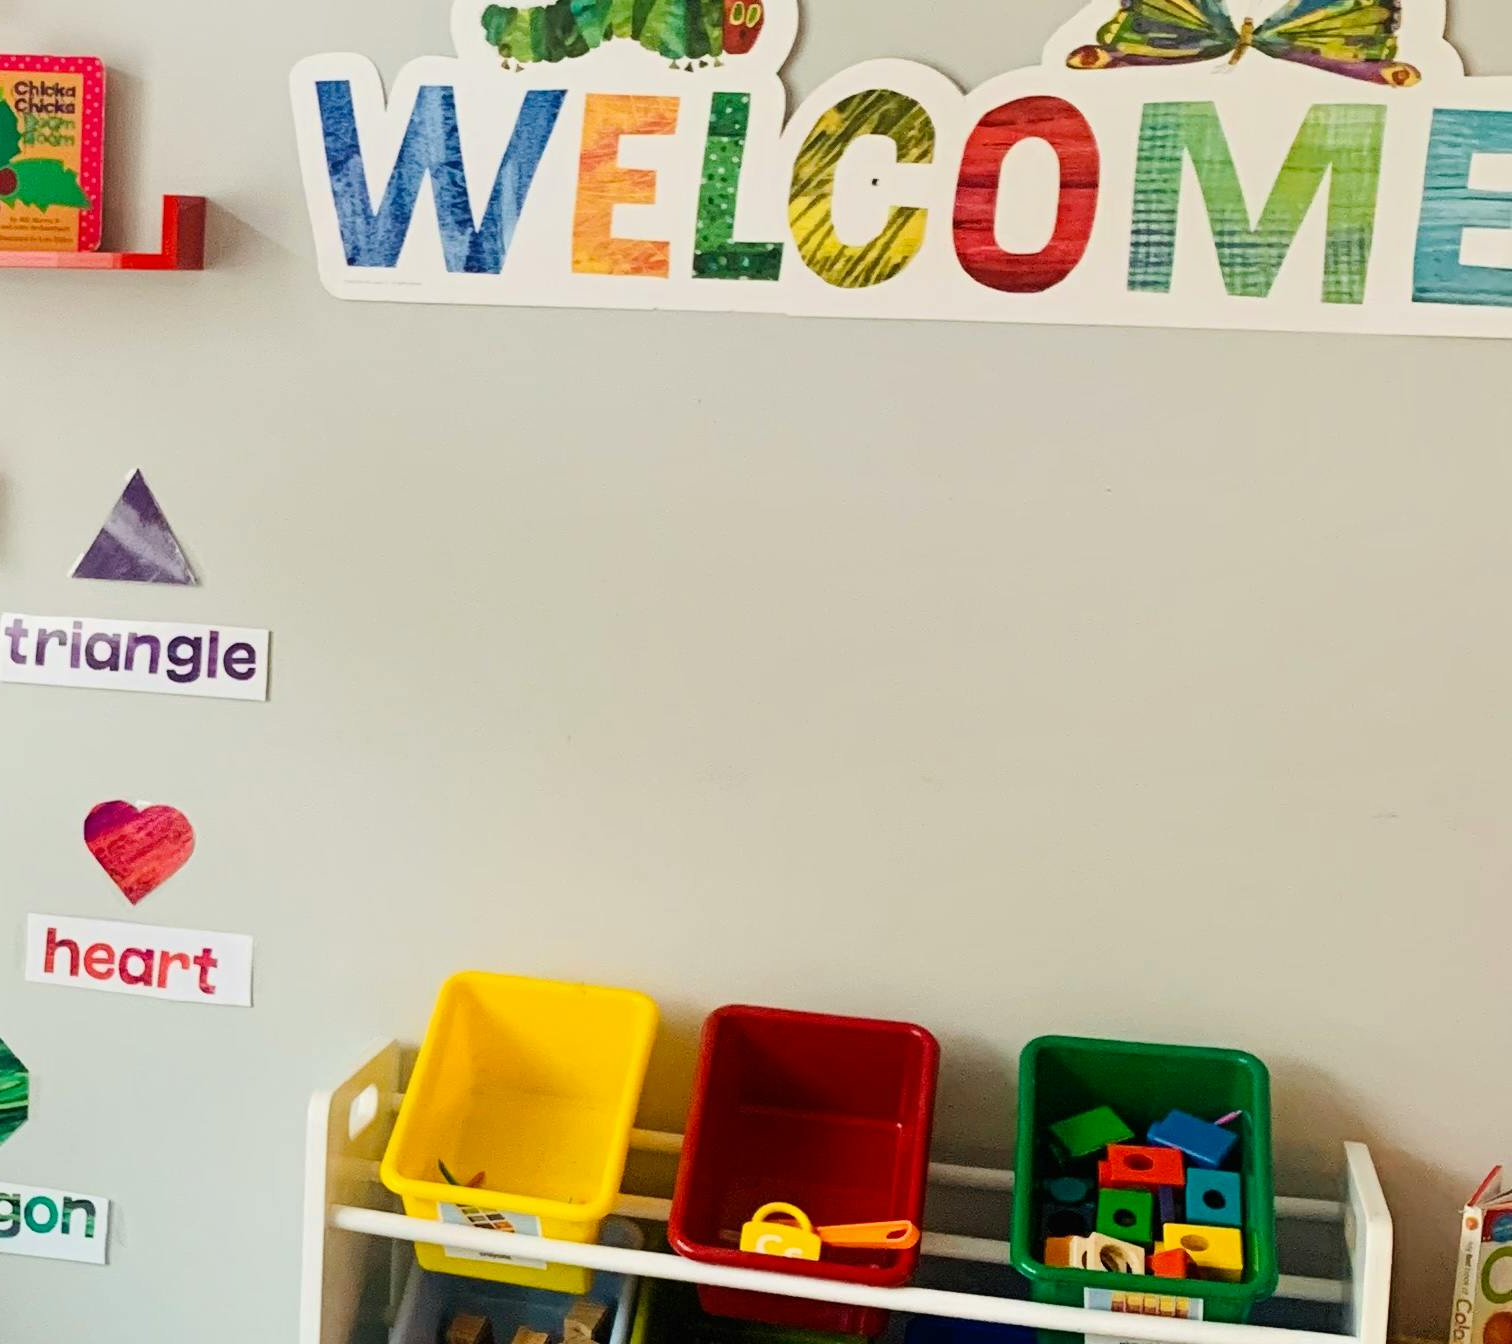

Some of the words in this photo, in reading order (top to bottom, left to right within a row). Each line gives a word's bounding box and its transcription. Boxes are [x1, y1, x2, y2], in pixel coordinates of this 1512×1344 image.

[14, 80, 76, 98] Chicka
[14, 98, 76, 114] Chicka
[313, 79, 1512, 307] WELCOME
[4, 617, 257, 684] triangle
[44, 927, 218, 995] heart
